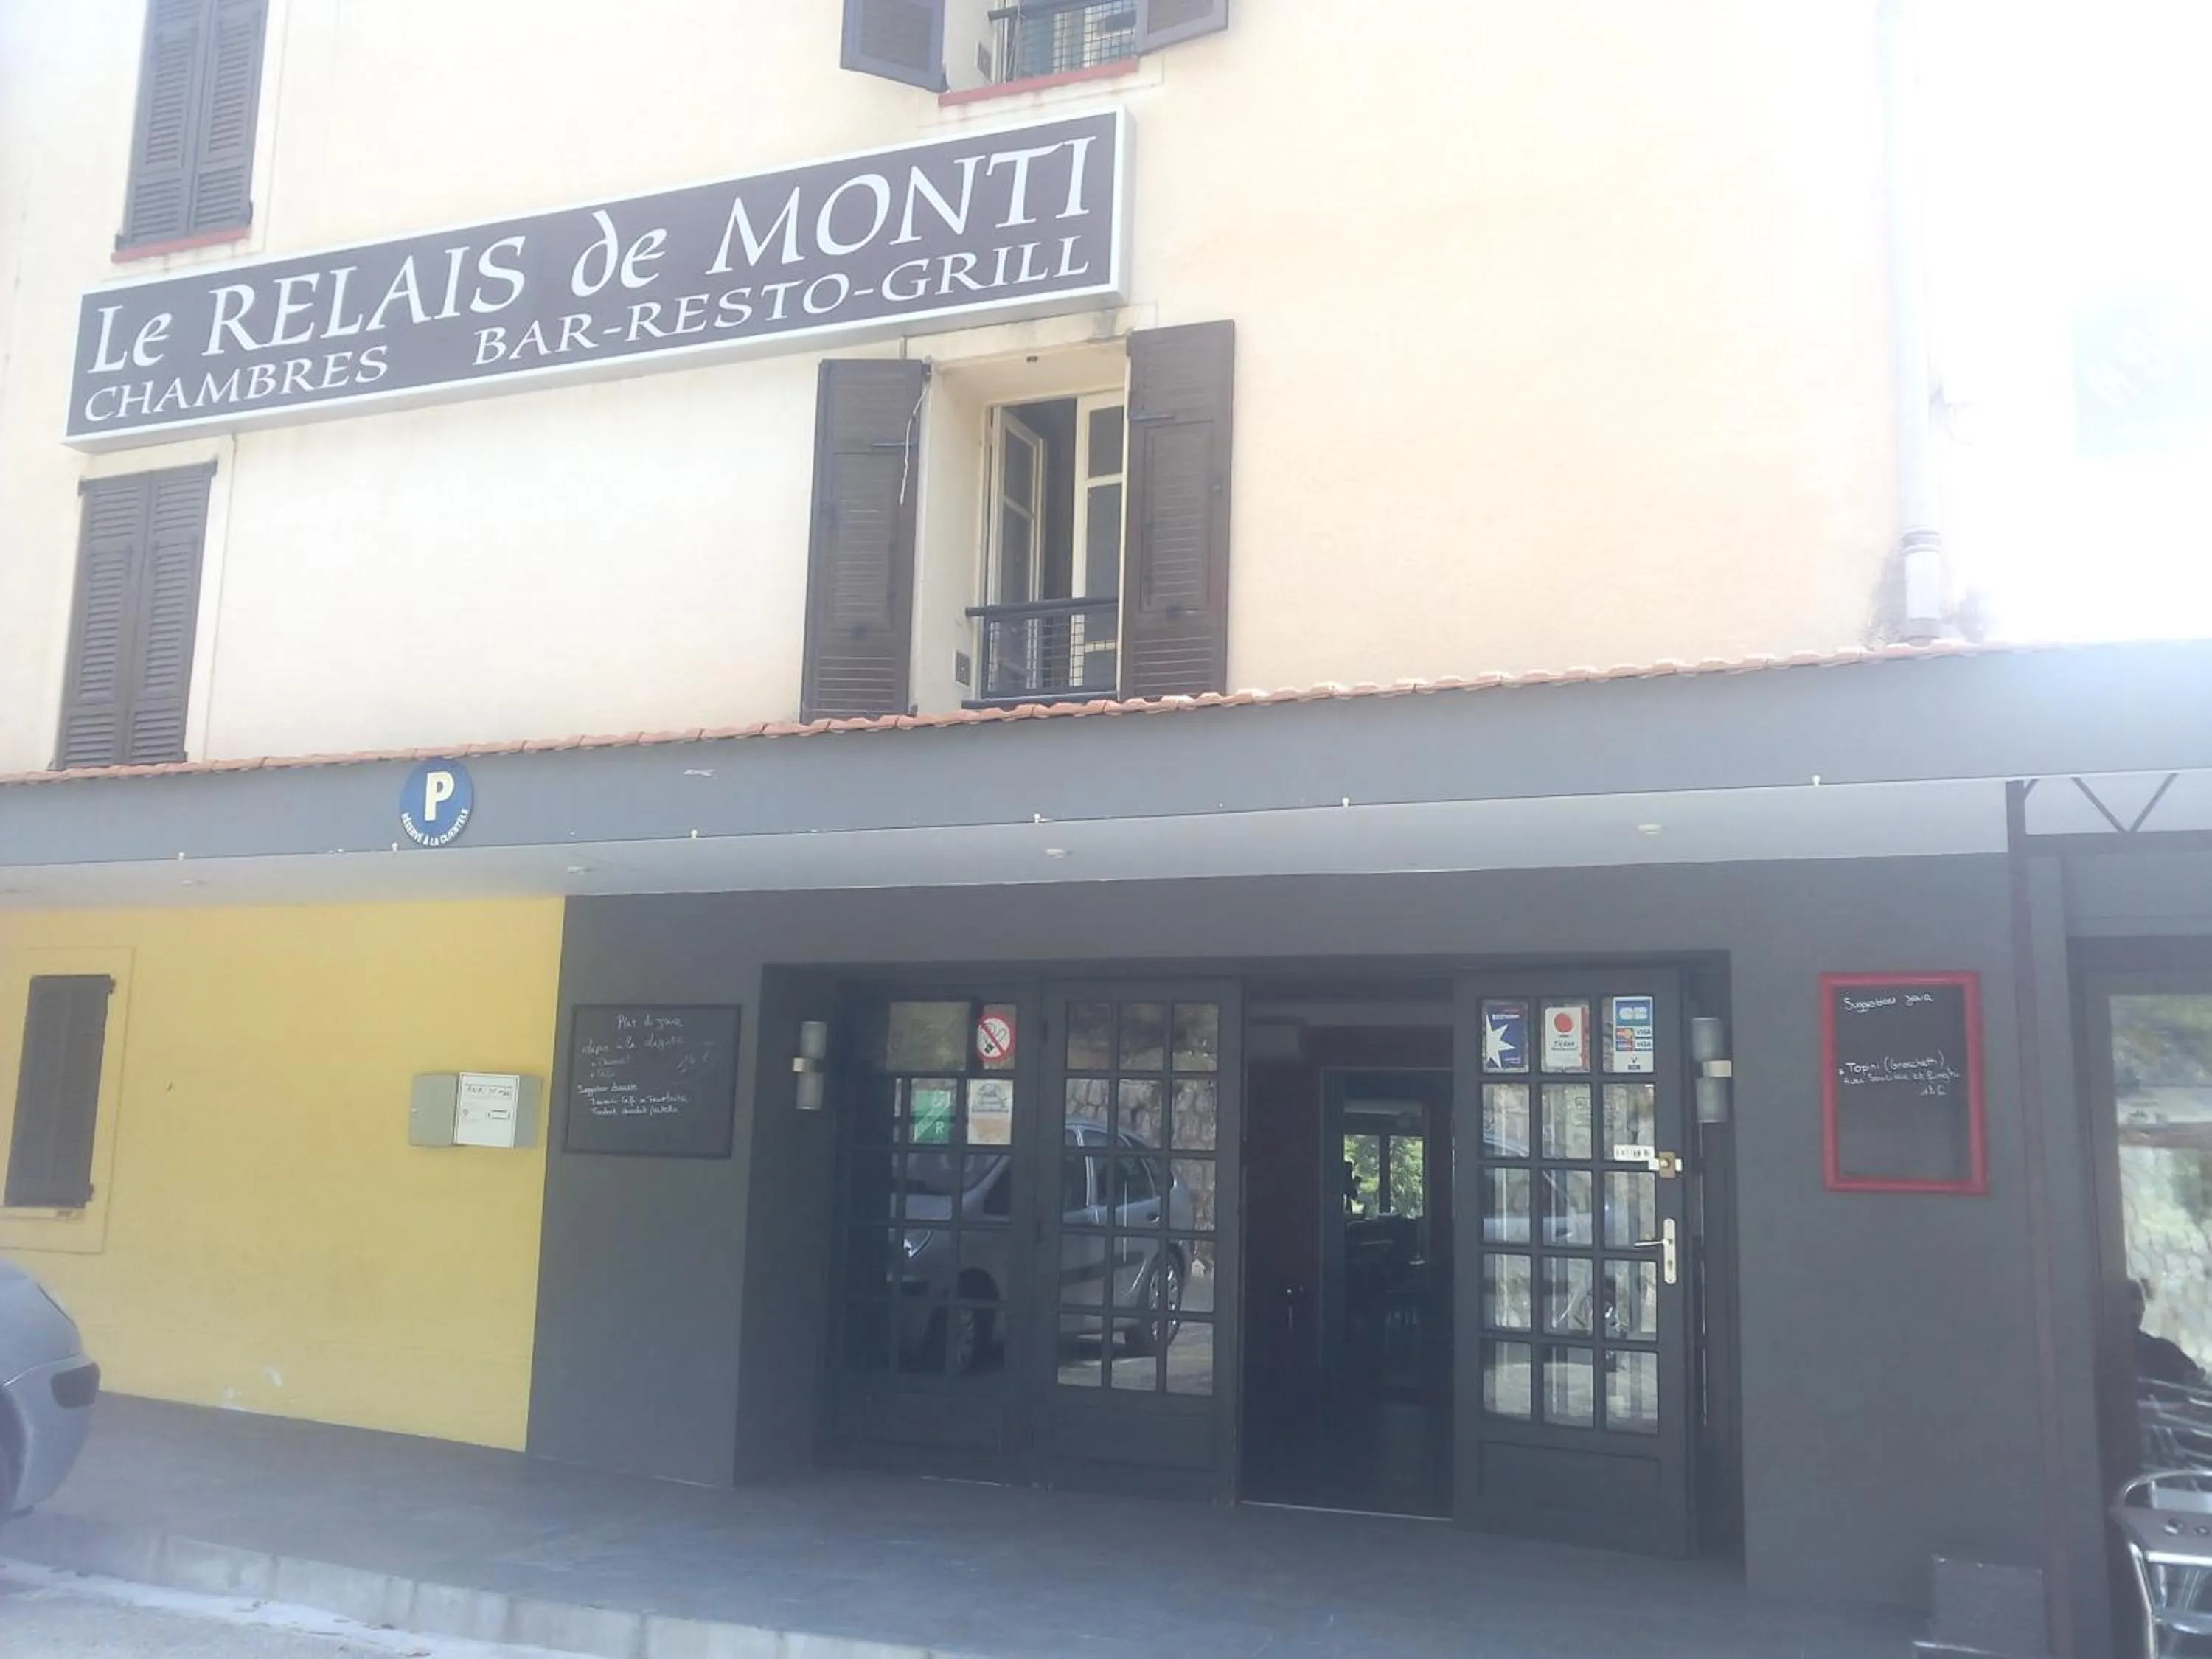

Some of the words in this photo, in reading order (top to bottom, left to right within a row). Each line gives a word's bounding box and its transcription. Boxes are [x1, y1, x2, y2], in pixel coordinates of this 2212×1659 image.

[84, 345, 389, 422] CHAMBRES
[472, 234, 1090, 366] BAR-RESTO-GRILL
[88, 305, 173, 374] Le
[201, 235, 526, 357] RELAIS
[571, 210, 668, 298] de
[705, 136, 1096, 276] MONTI
[424, 771, 454, 821] P
